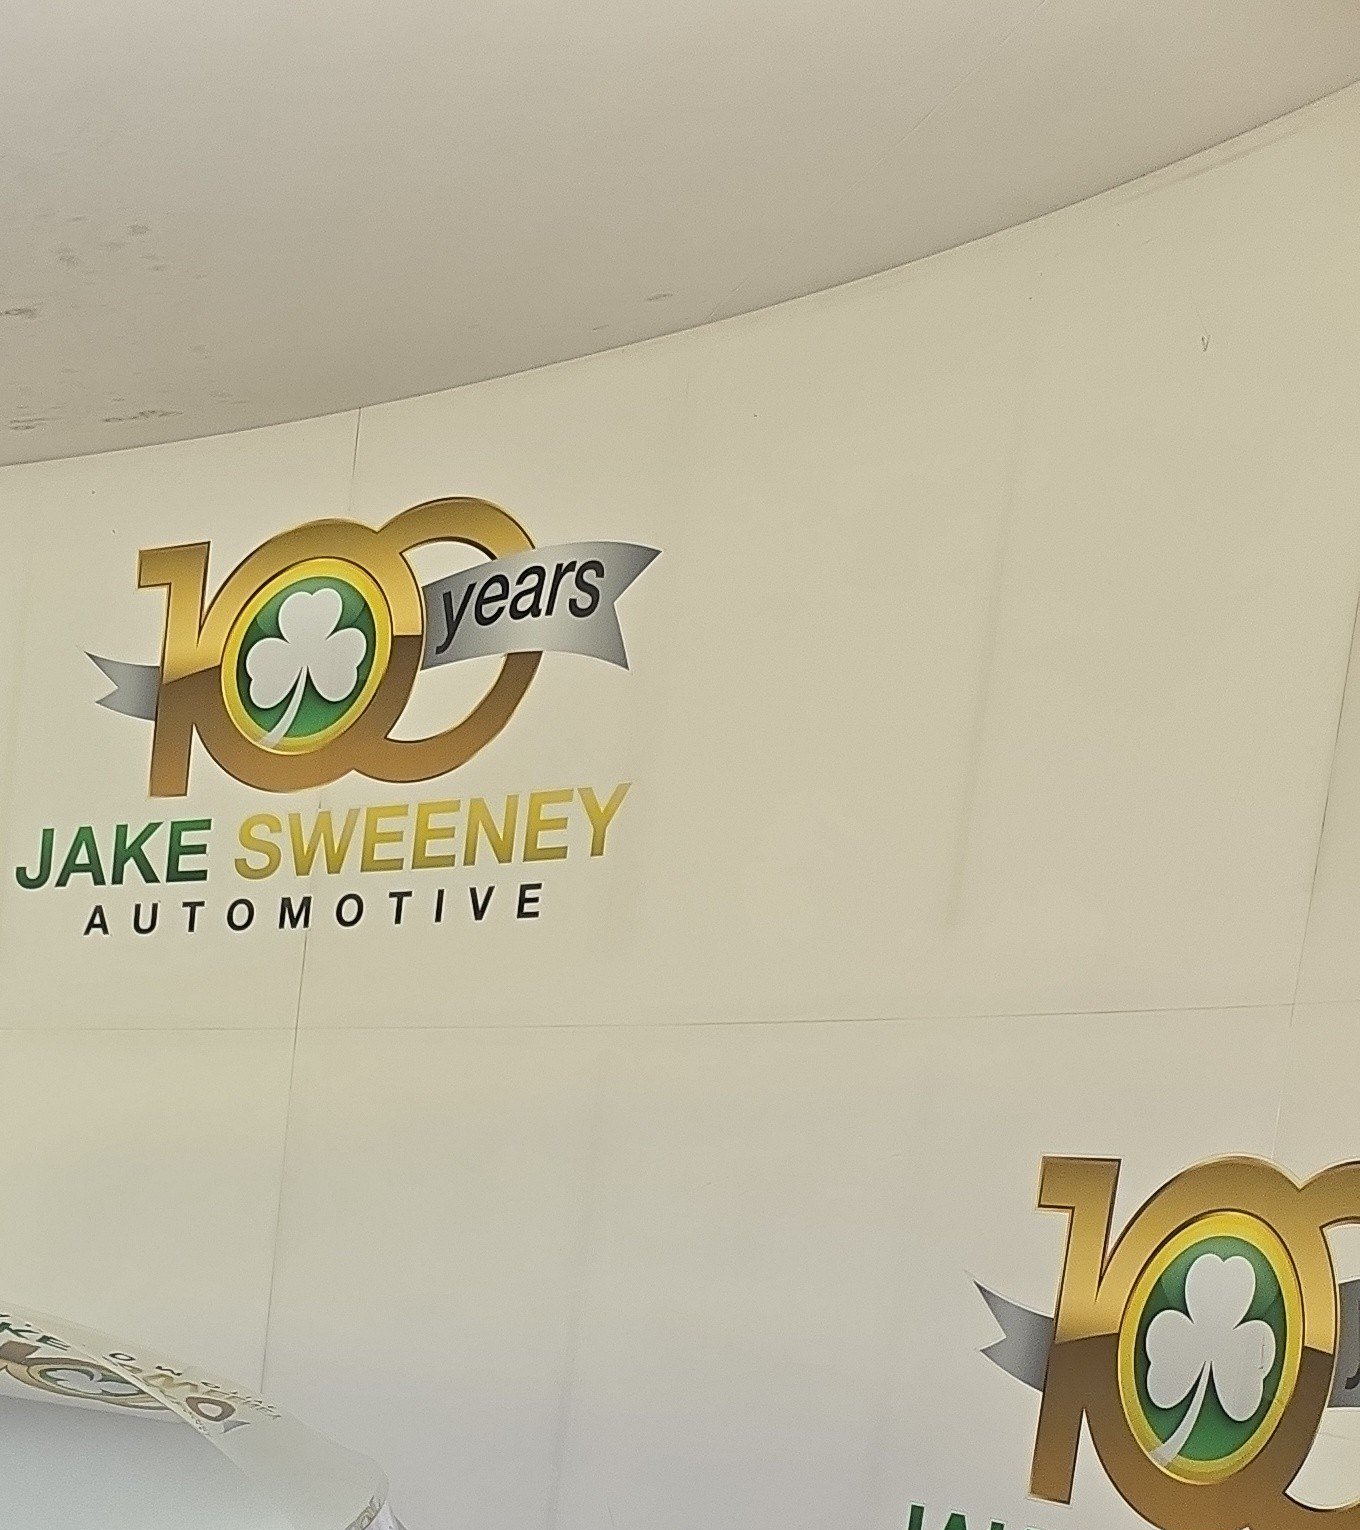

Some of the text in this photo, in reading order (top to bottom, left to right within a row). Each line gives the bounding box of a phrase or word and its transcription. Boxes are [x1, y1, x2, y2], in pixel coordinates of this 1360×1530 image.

[136, 496, 546, 798] 100
[435, 559, 606, 656] years
[15, 781, 634, 889] JAKE SWEENEY
[84, 882, 544, 936] AUTOMOTIVE
